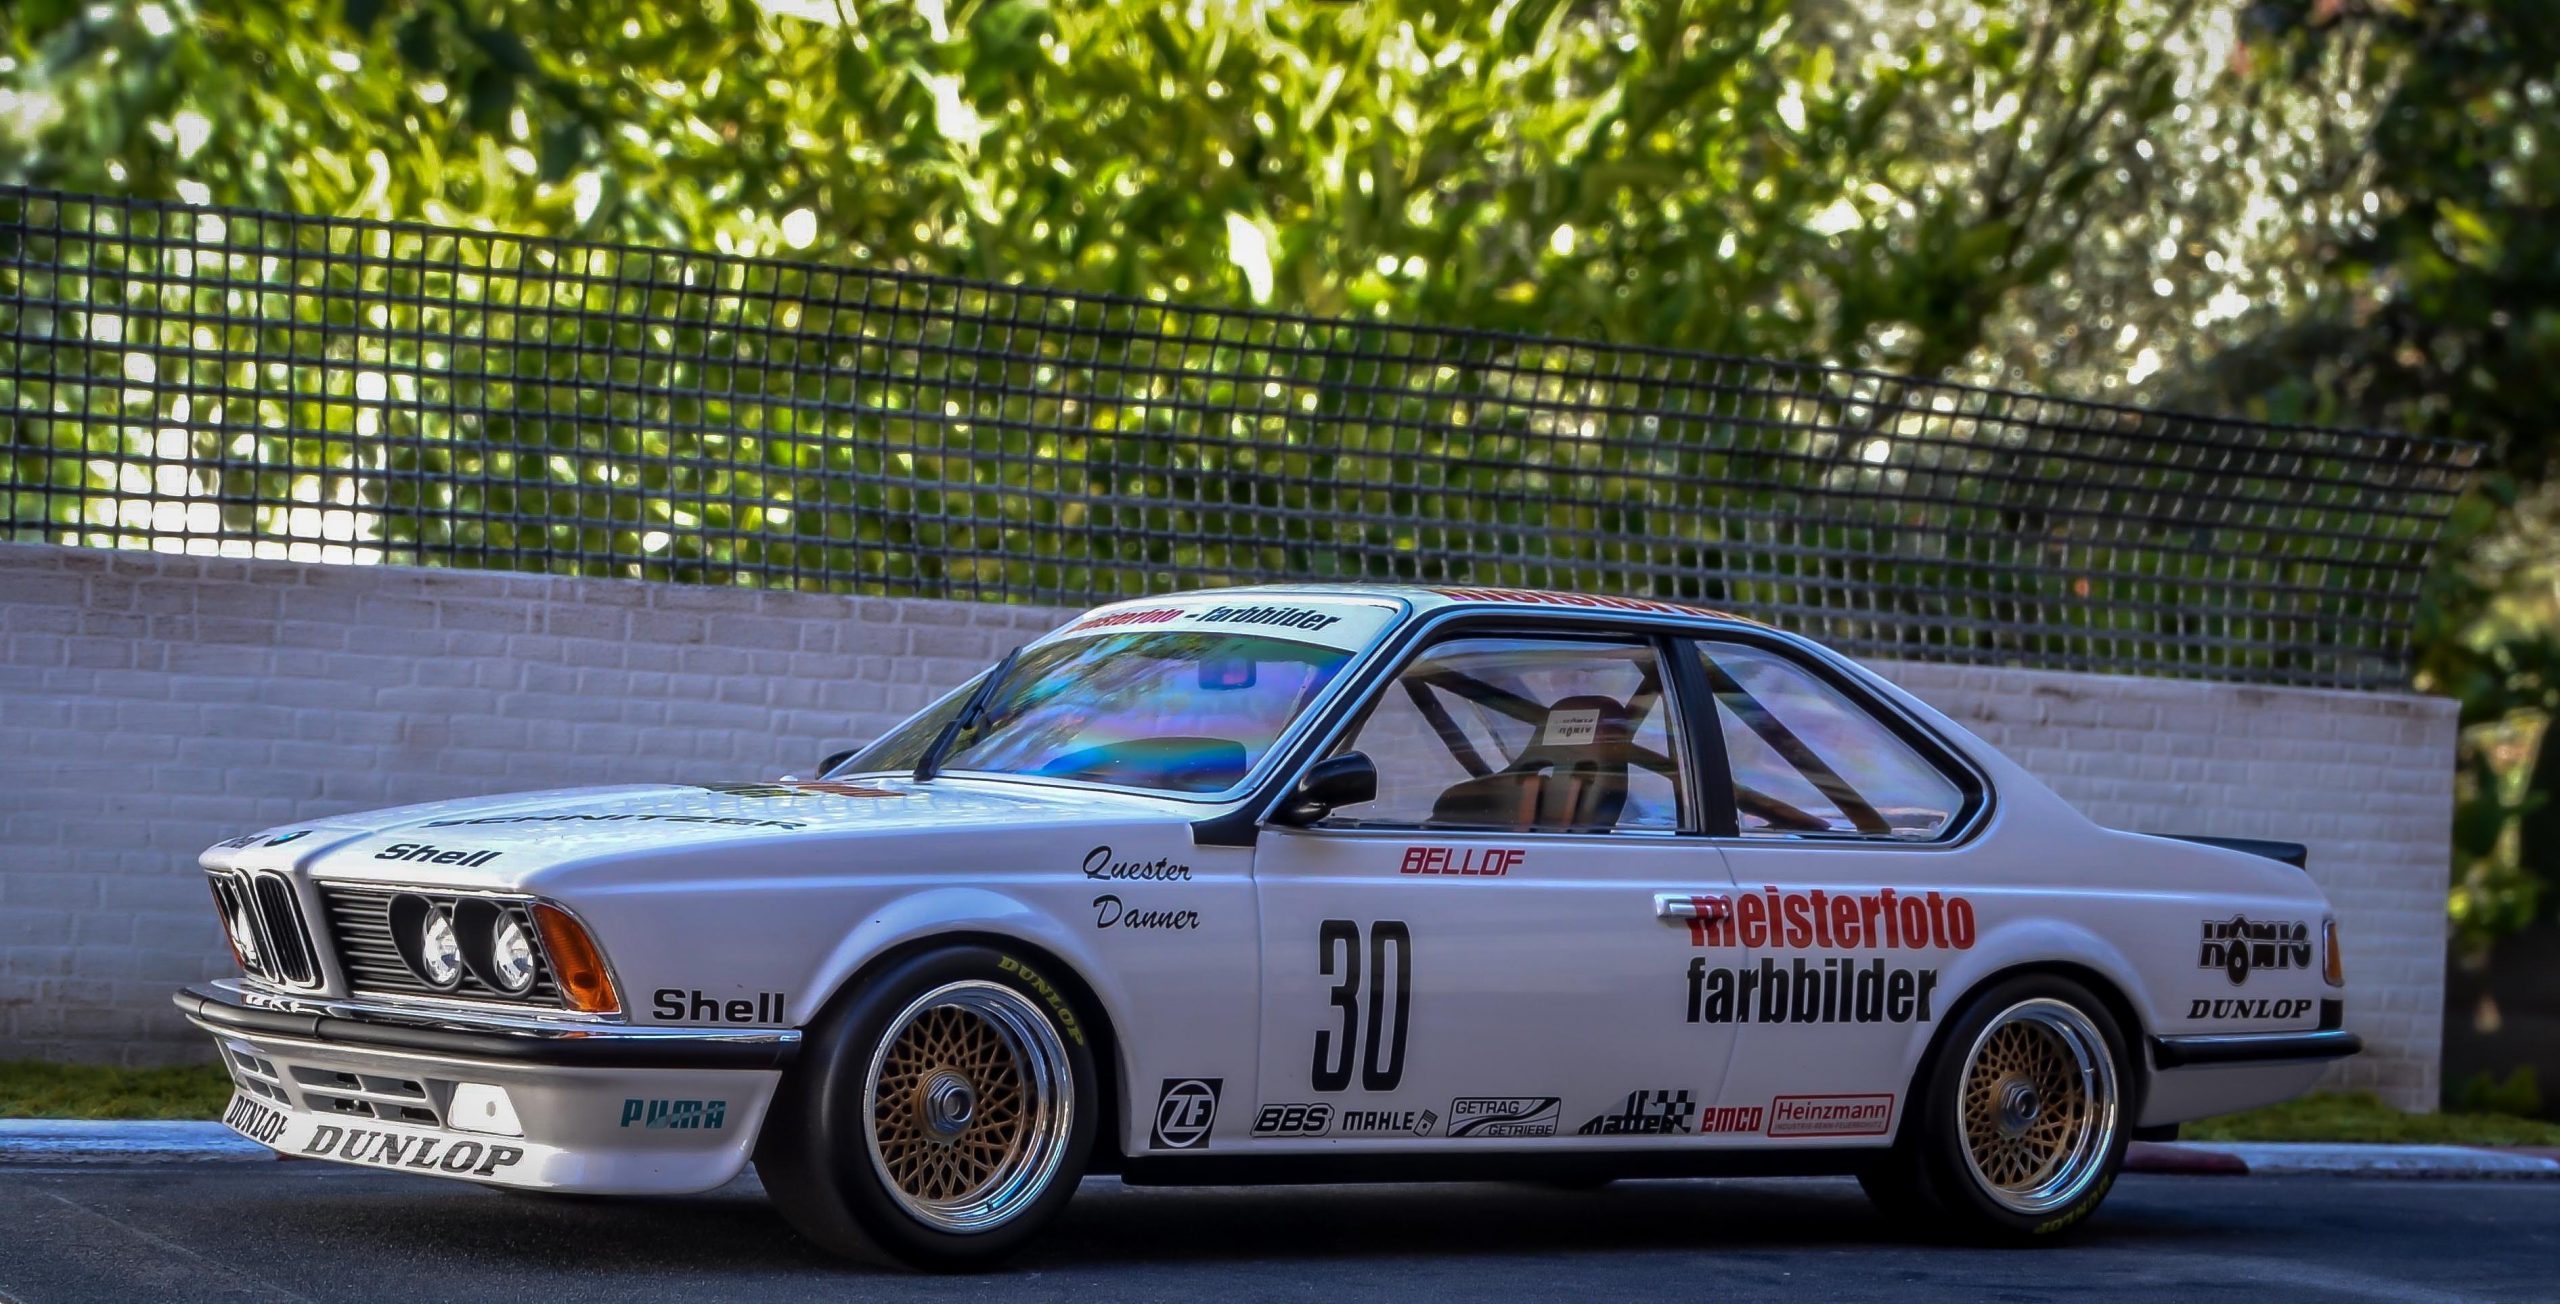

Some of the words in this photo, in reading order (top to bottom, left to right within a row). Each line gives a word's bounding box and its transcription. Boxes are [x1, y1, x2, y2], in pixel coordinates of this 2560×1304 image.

[1197, 606, 1342, 631] farbbilder
[419, 814, 807, 830] SCHNITZER
[375, 843, 503, 868] Shell
[1082, 845, 1193, 882] Quester
[1401, 847, 1526, 876] BELLOF
[1092, 894, 1201, 930] Danner
[1685, 885, 1976, 950] meisterfoto
[652, 988, 785, 1024] Shell
[998, 954, 1084, 1046] DUNLOP
[1312, 919, 1412, 1092] 30
[1686, 956, 1938, 1024] farbbilder
[2186, 999, 2313, 1020] DUNLOP
[225, 1095, 288, 1144] DUNLOP
[620, 1098, 727, 1129] PUMA
[1162, 1094, 1214, 1134] ZF
[1251, 1103, 1335, 1138] BBS
[1341, 1110, 1415, 1131] MAHLE
[1455, 1100, 1521, 1115] GETRAG
[1777, 1102, 1886, 1121] Heinzmann
[1488, 1124, 1553, 1137] GETRIEBE
[301, 1124, 525, 1177] DUNLOP
